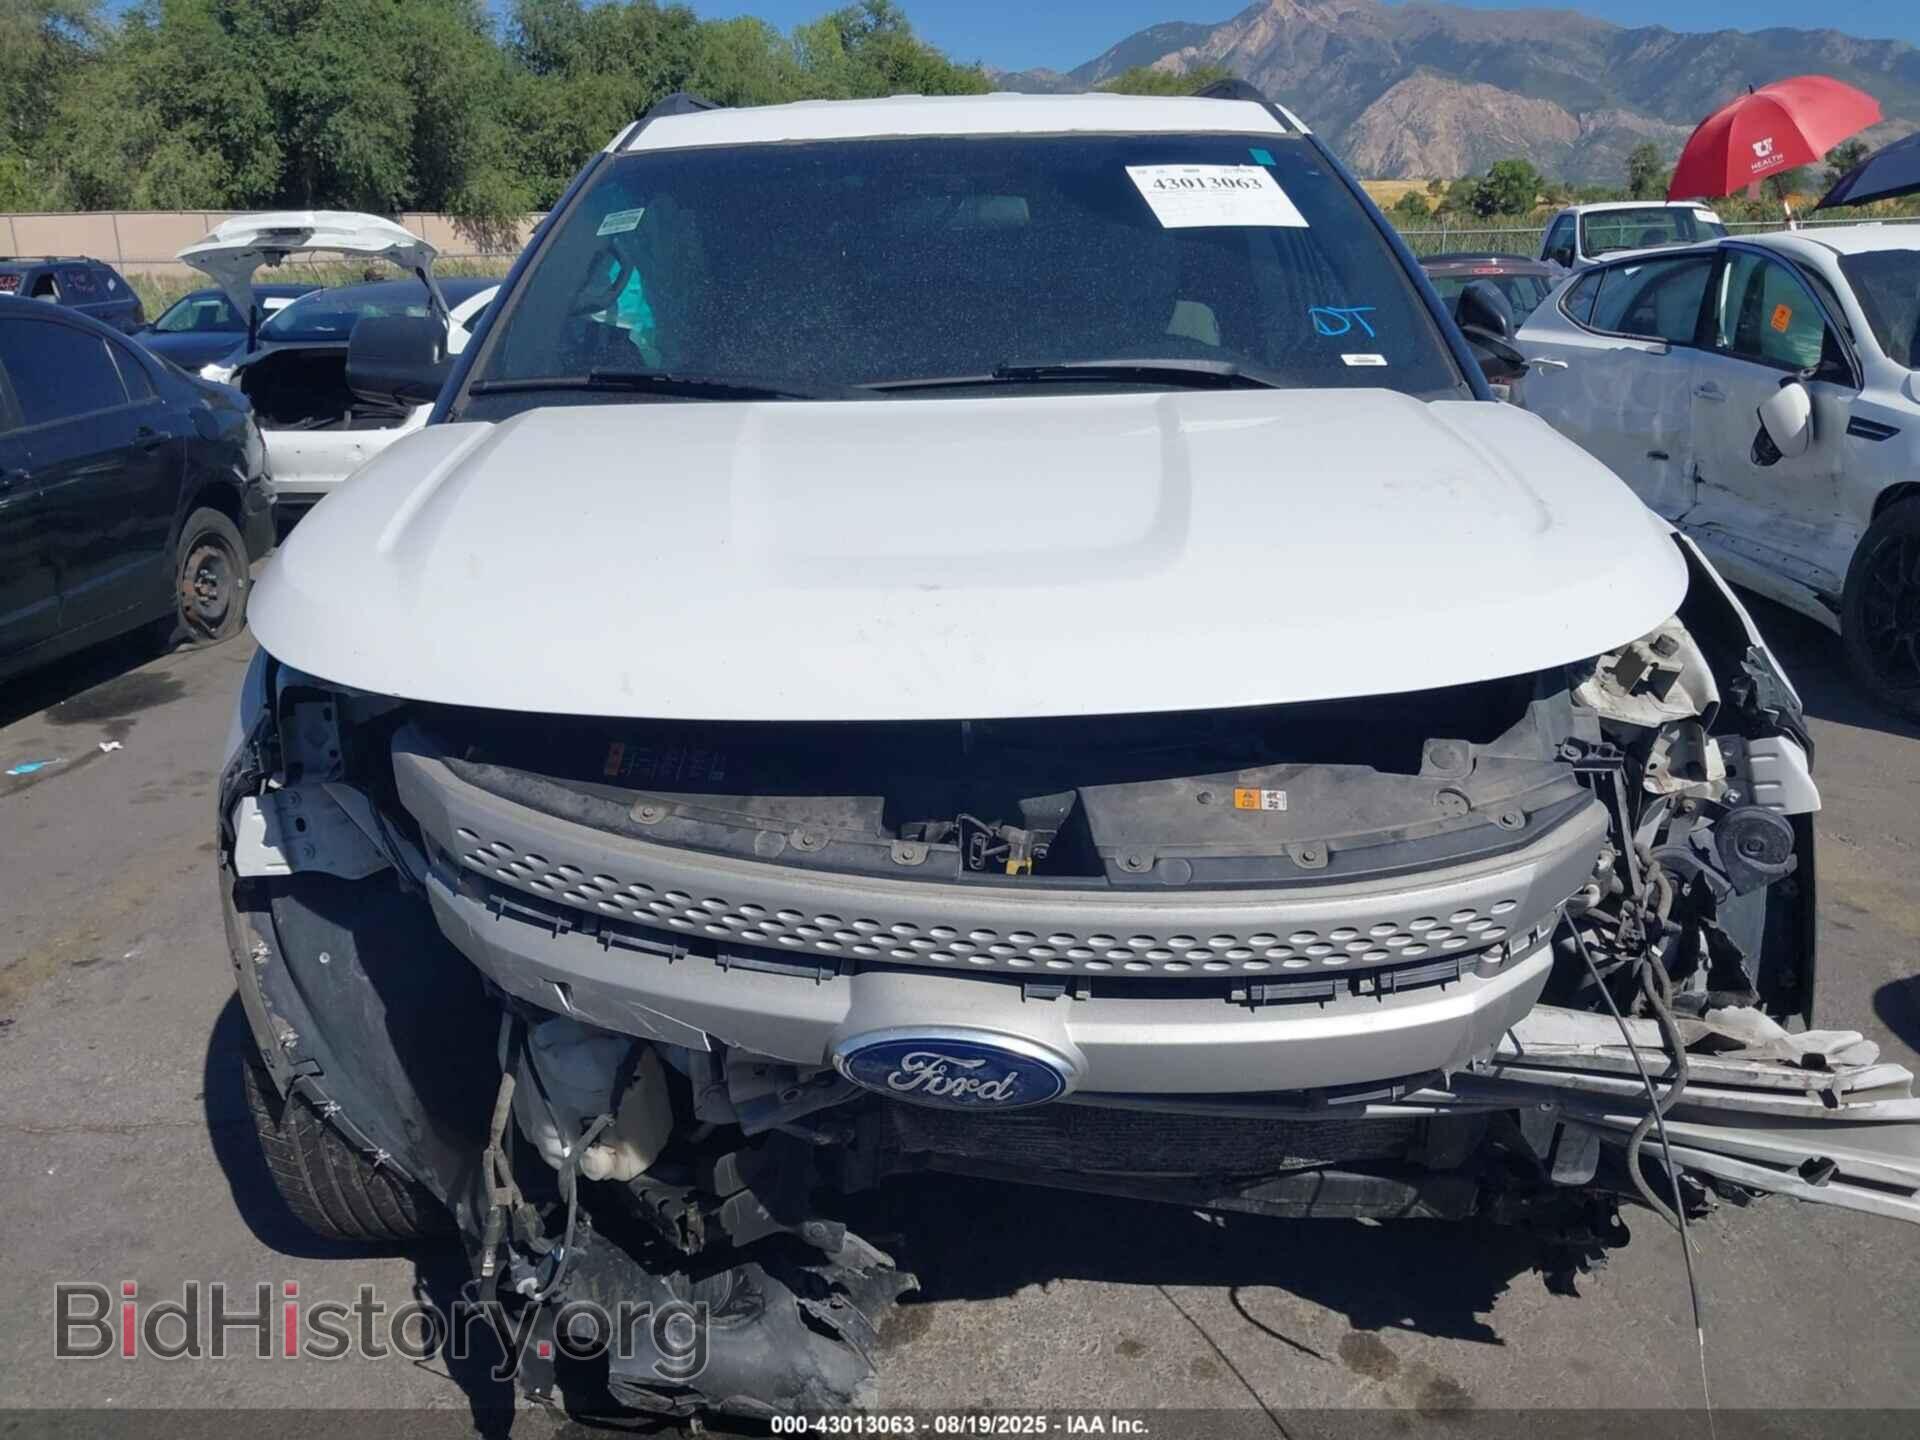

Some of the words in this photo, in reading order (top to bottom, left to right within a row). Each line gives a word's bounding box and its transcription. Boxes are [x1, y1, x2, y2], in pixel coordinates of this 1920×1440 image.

[1751, 153, 1784, 171] HEALTH
[1152, 176, 1263, 190] 43013063
[887, 1051, 1018, 1101] Ford
